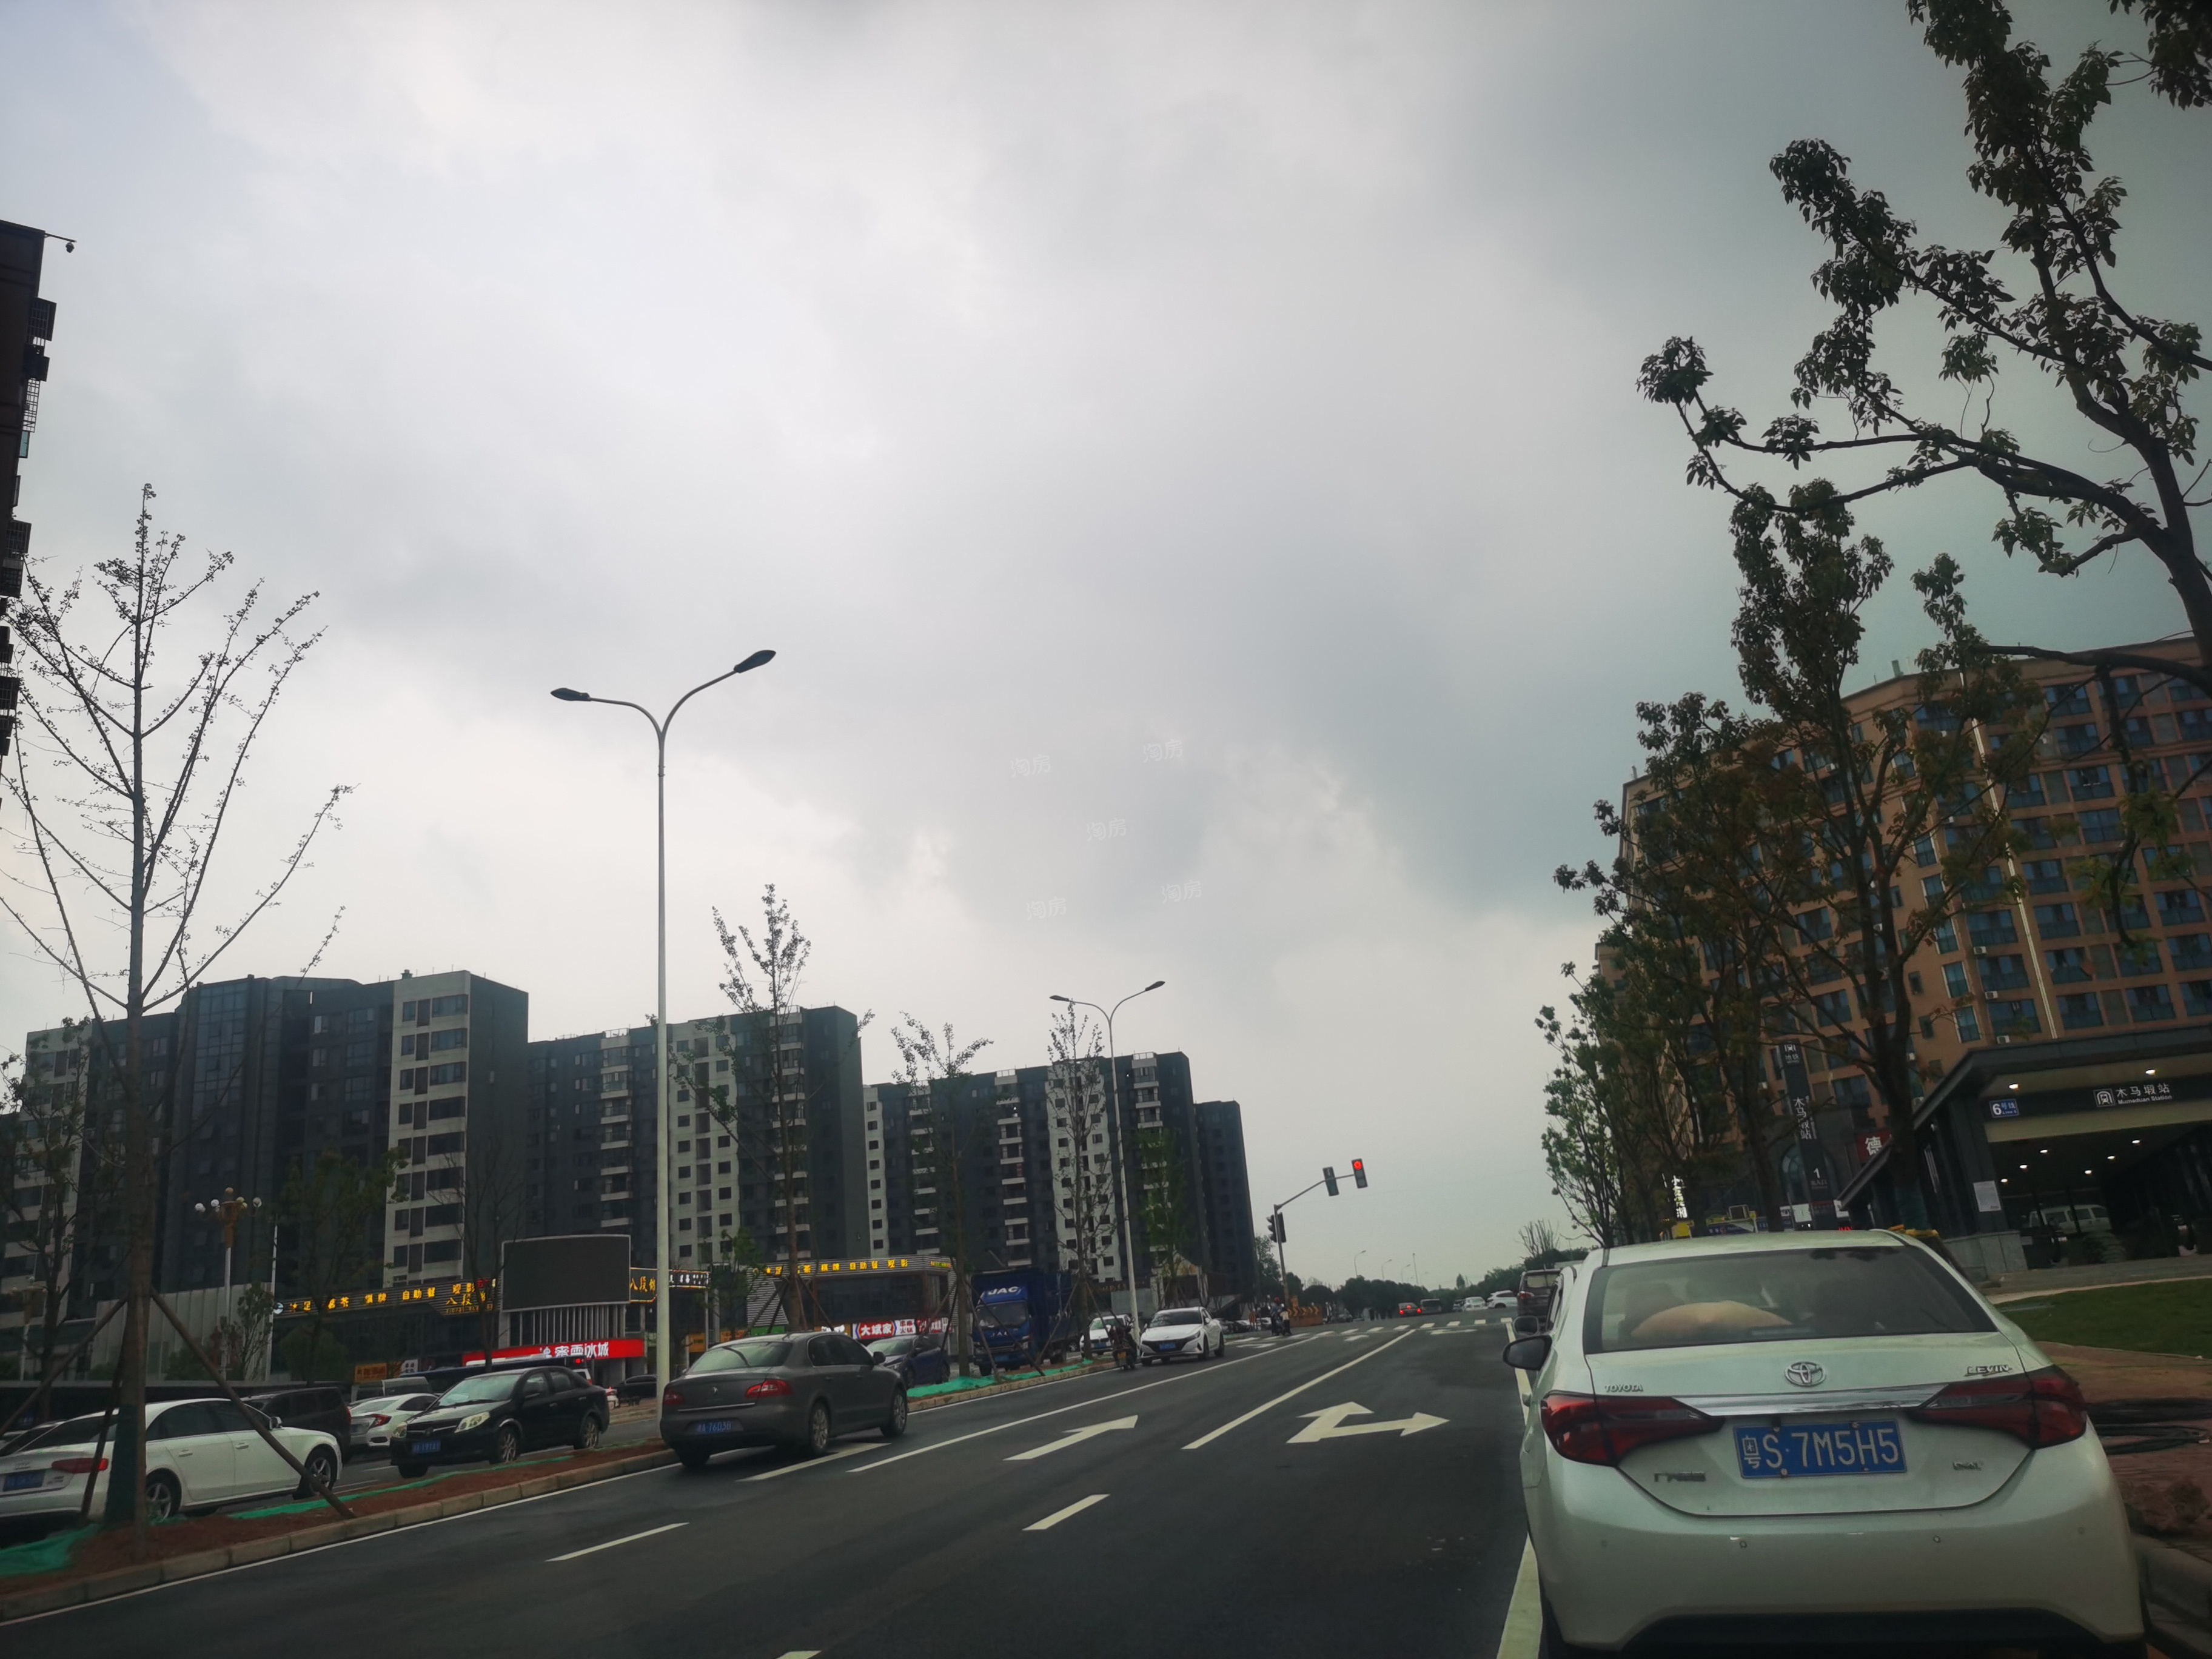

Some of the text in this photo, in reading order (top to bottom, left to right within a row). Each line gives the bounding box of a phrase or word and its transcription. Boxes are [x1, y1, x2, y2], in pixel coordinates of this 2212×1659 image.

[1865, 1136, 1883, 1156] 德
[1814, 1168, 1820, 1179] 1
[988, 1286, 1019, 1295] JAC
[1966, 1364, 2011, 1375] LEVIN
[1604, 1383, 1643, 1393] TOYOTA
